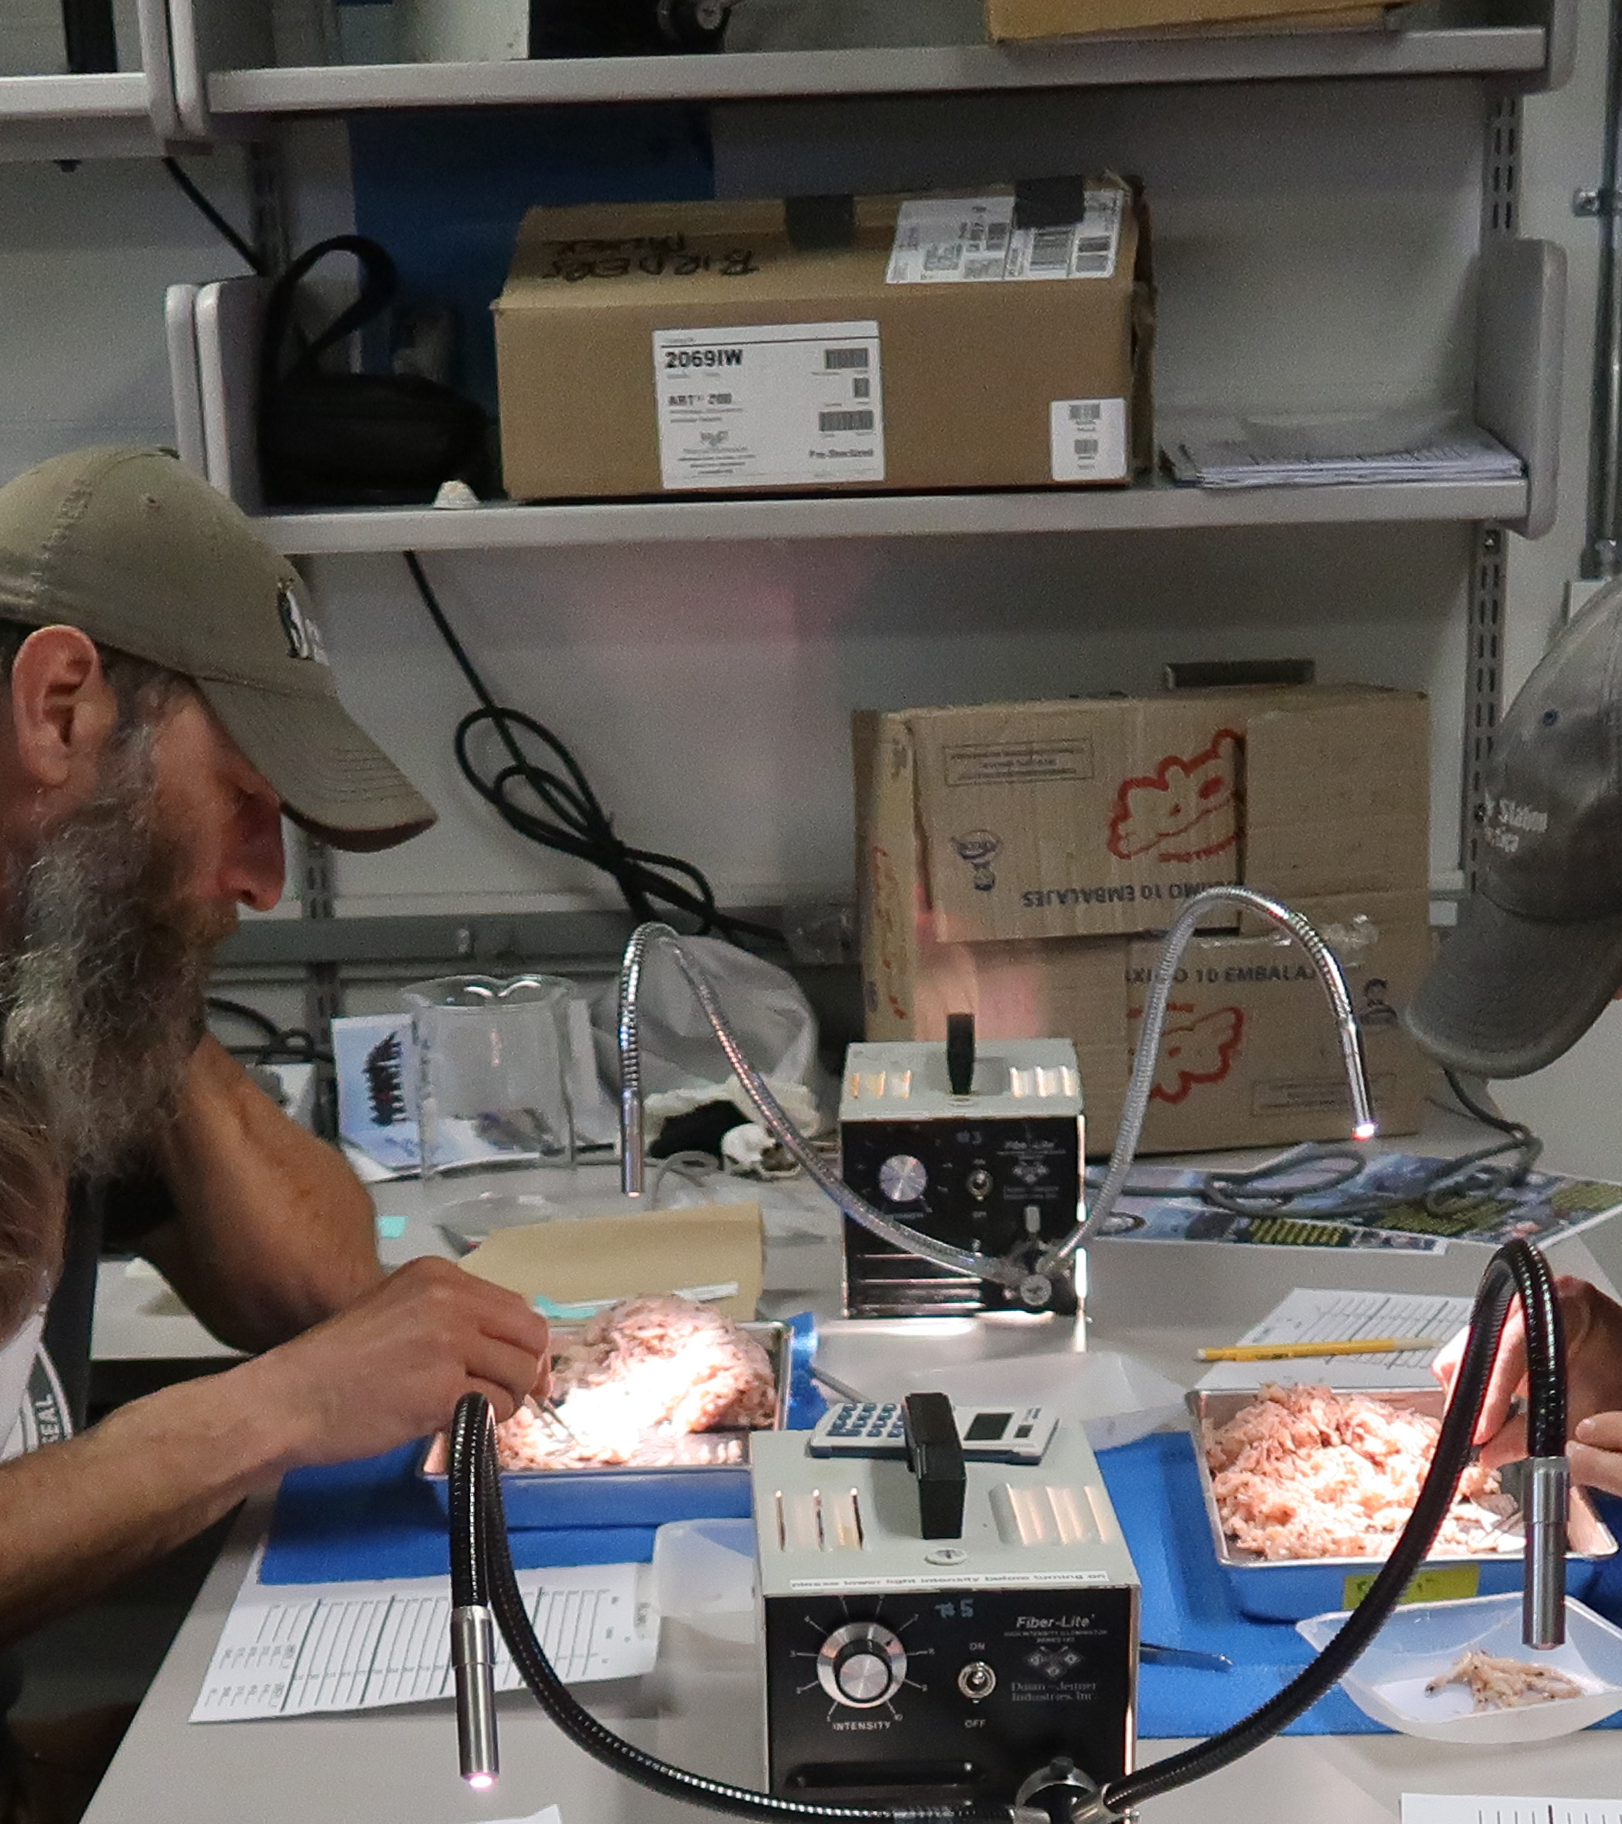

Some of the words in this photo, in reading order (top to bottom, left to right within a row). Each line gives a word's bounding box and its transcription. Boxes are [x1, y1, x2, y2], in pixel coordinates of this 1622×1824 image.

[665, 349, 743, 369] 2069IW
[1023, 884, 1135, 908] EMBALAJES
[1016, 1616, 1091, 1629] Fiber-Lite
[969, 1642, 986, 1651] ON
[832, 1721, 891, 1731] INTENSITY
[964, 1719, 986, 1729] OFF
